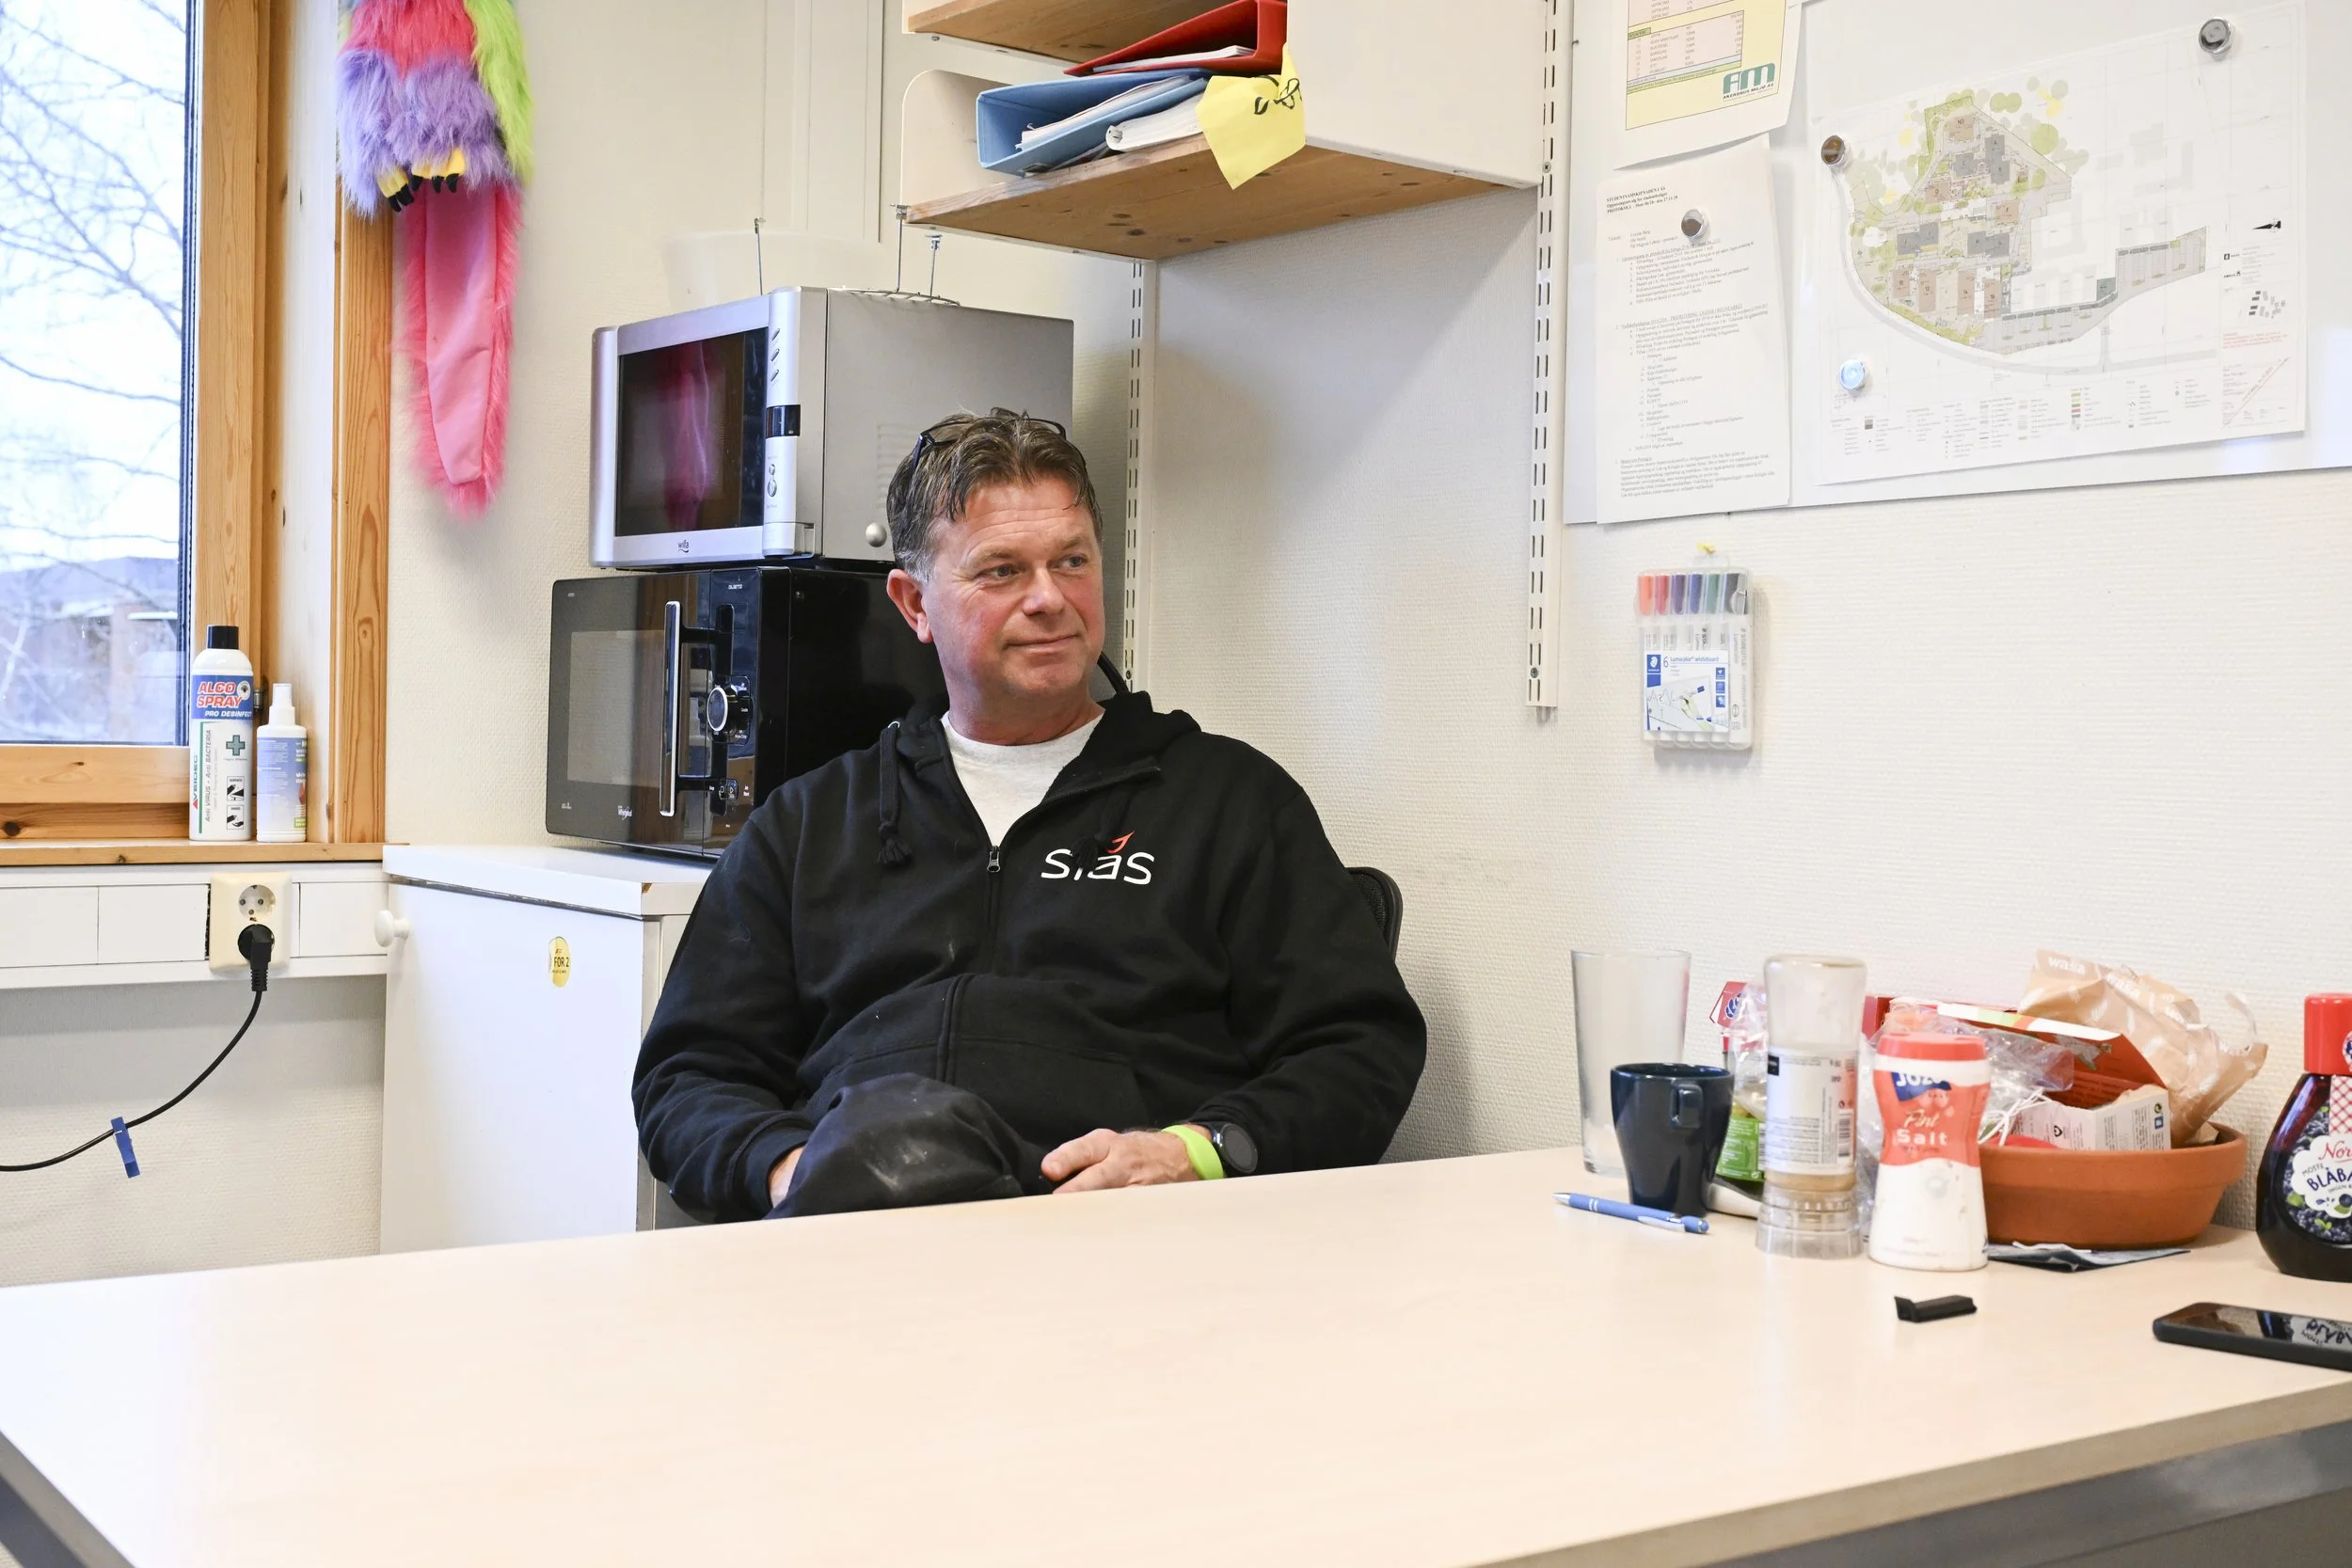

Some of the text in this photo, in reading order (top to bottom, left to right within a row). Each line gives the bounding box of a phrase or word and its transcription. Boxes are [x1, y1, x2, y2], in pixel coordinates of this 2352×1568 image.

[1723, 89, 1750, 99] AKERSHUS
[1662, 657, 1670, 668] 6
[198, 681, 236, 695] ALCO
[197, 695, 243, 708] SPRAY
[565, 957, 570, 968] 2
[1896, 1129, 1947, 1146] Salt
